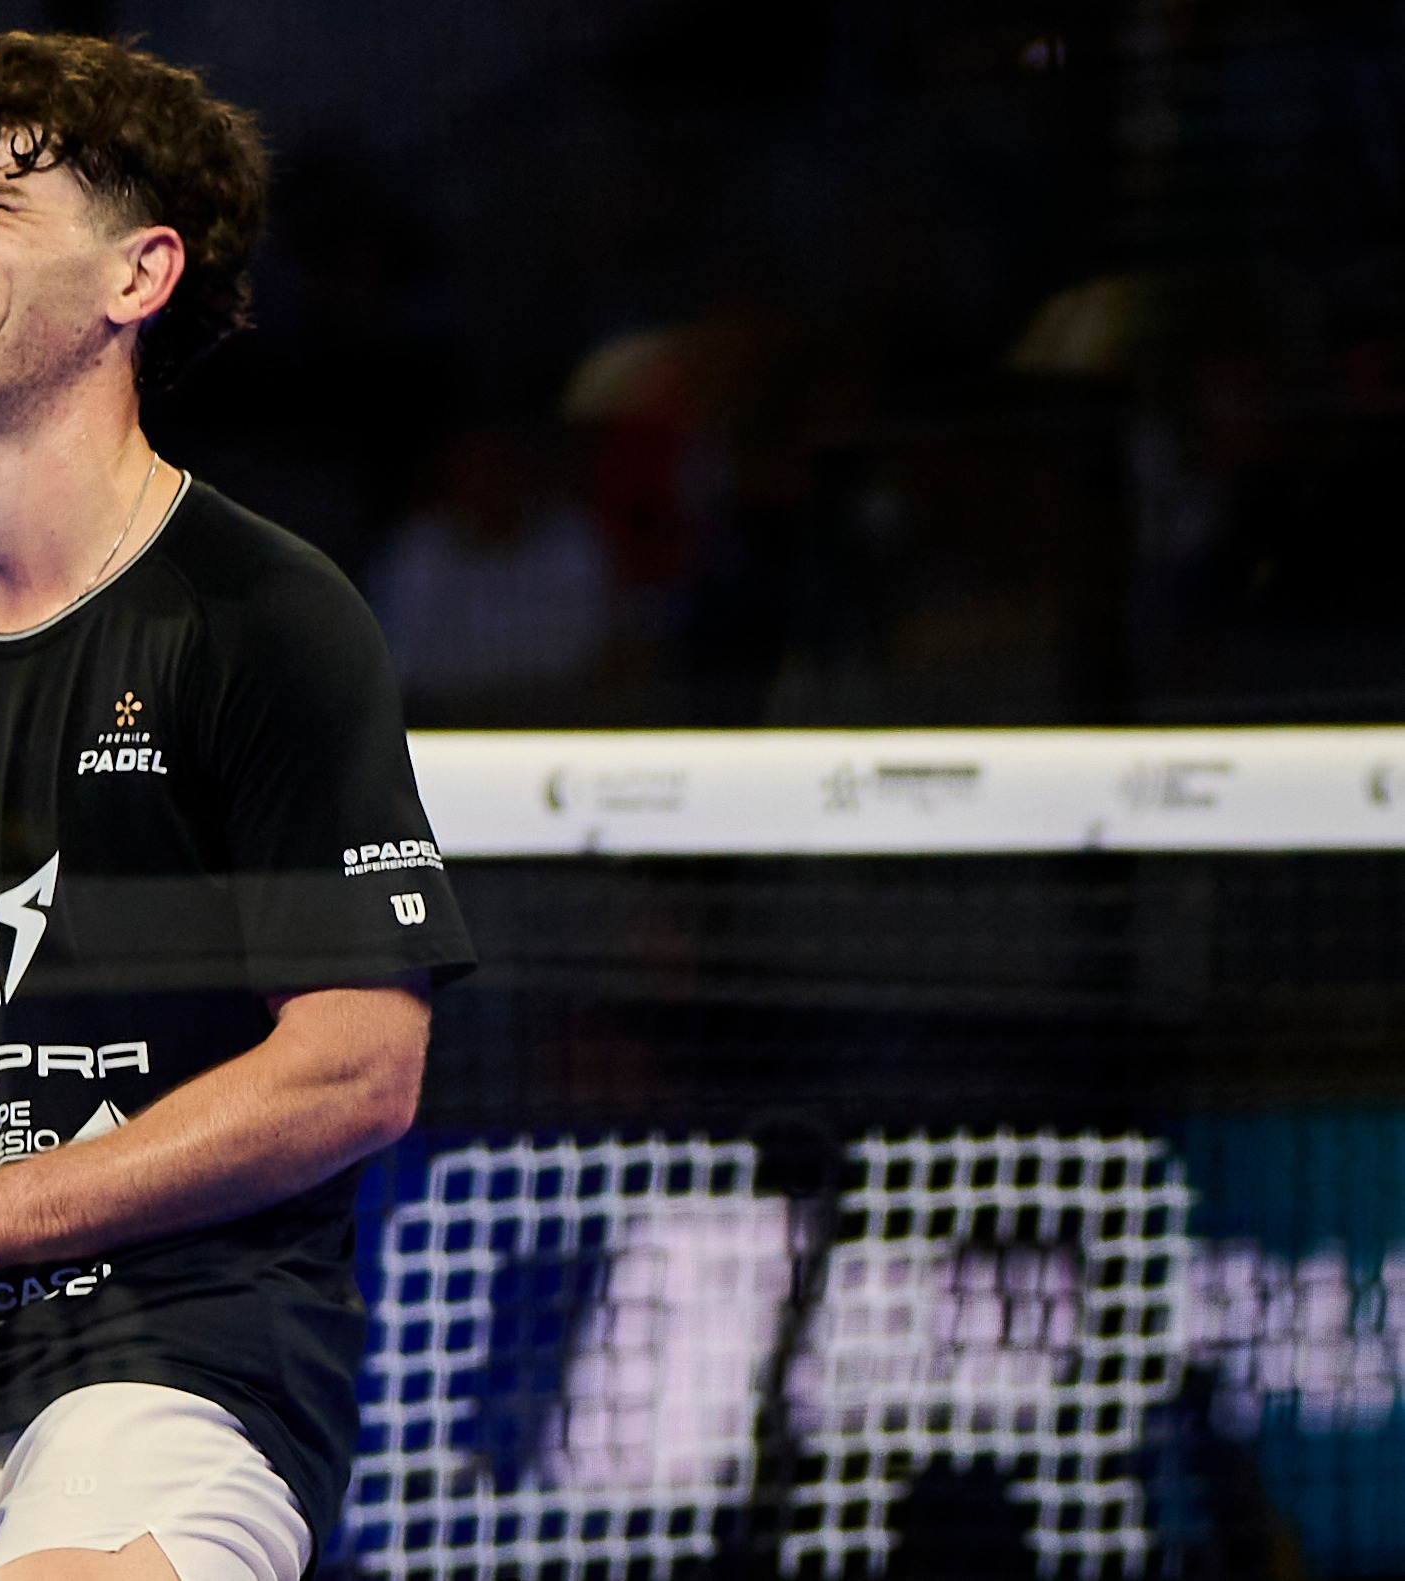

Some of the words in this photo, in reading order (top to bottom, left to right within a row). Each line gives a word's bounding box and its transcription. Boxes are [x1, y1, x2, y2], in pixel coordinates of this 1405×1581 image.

[98, 732, 150, 744] PREMIER
[78, 748, 168, 775] PADEL
[360, 839, 442, 863] PADEL
